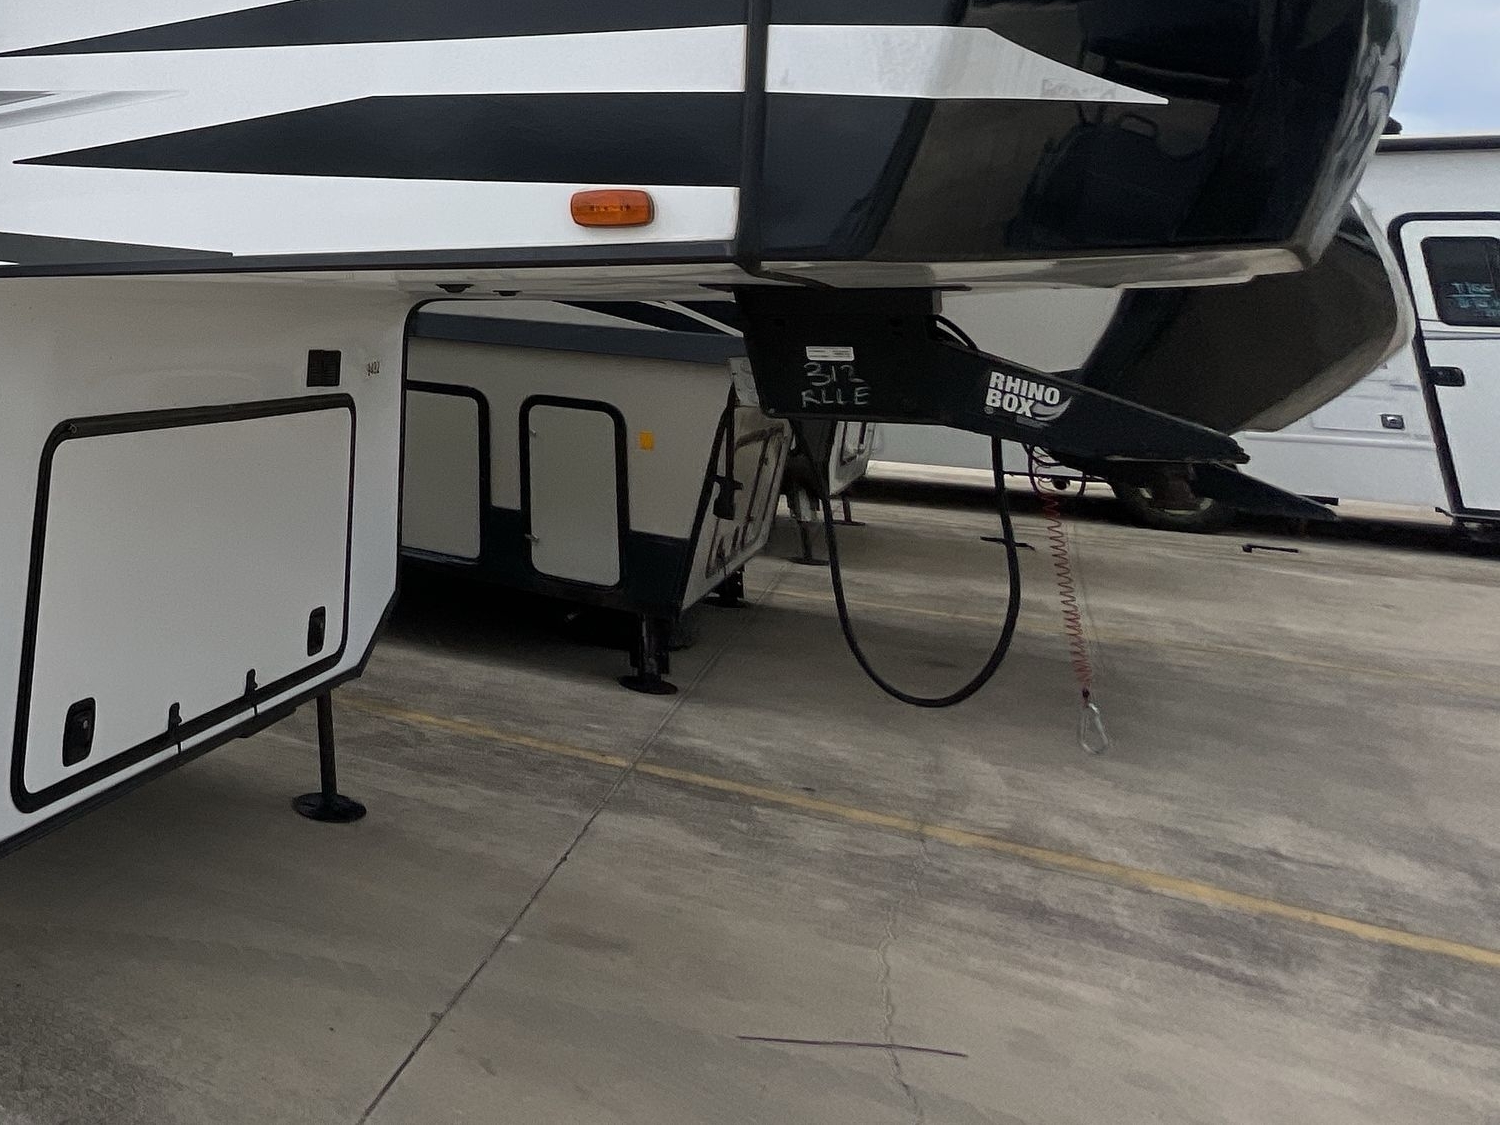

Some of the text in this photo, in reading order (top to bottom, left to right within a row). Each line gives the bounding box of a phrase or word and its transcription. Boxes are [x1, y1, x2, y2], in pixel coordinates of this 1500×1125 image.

[803, 362, 865, 386] 312
[989, 371, 1060, 405] RHINO
[985, 388, 1035, 417] BOX
